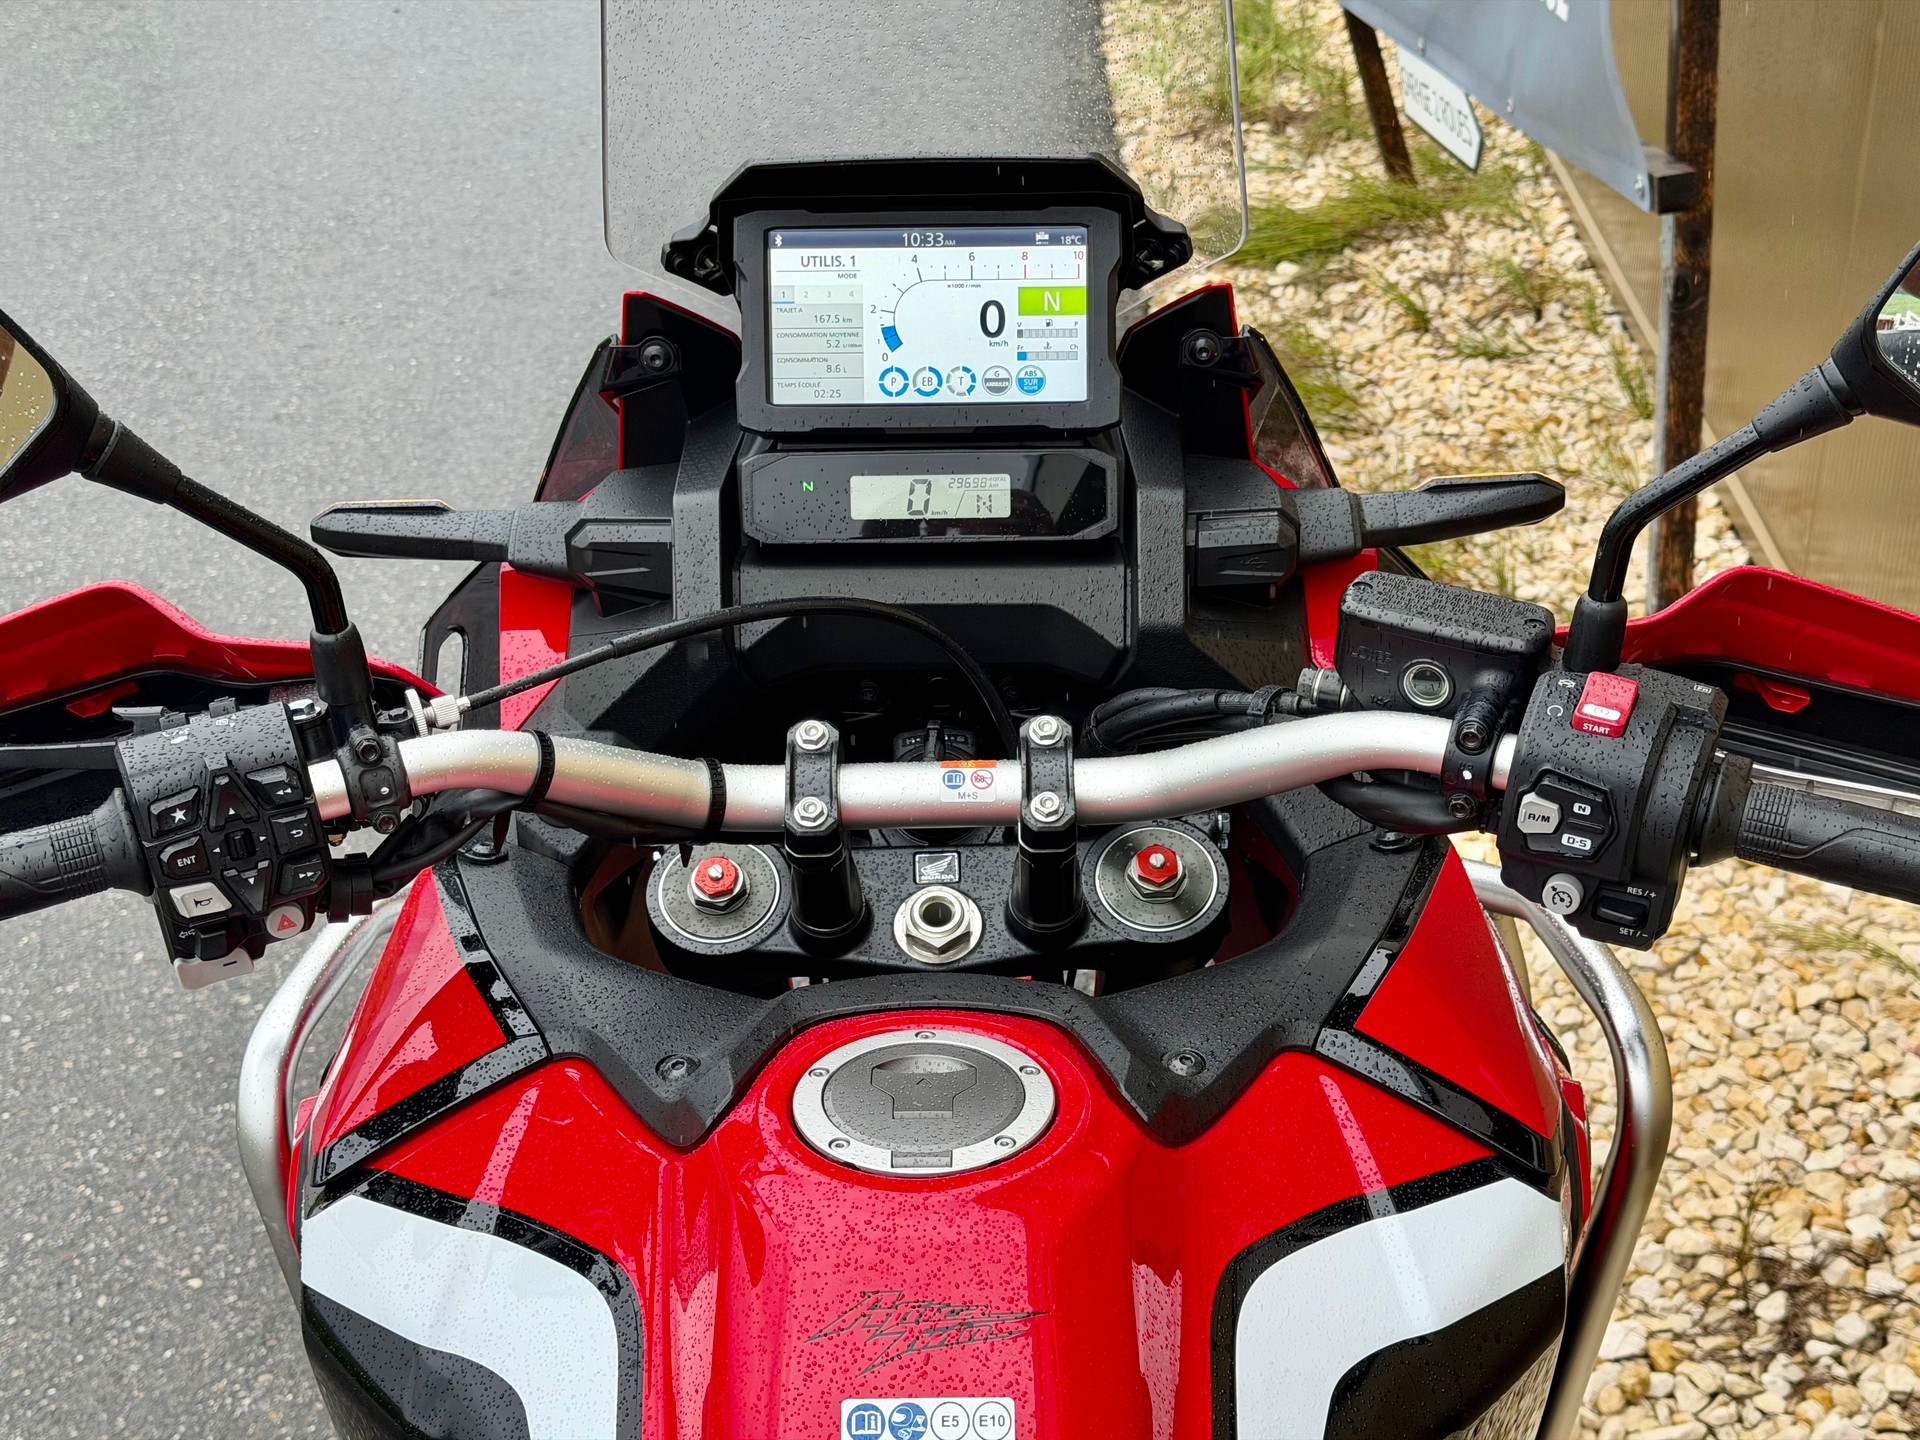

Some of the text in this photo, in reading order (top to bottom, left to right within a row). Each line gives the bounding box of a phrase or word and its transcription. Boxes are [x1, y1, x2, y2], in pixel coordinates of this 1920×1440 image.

[911, 254, 918, 264] 4
[968, 252, 976, 262] 6
[1021, 251, 1029, 261] 8
[1073, 250, 1084, 260] 10
[800, 255, 856, 268] UTILIS. 1
[781, 290, 854, 299] 1 2 3 4
[1043, 292, 1061, 311] N
[870, 304, 877, 314] 2
[813, 314, 841, 324] 167.5
[980, 300, 1006, 339] 0
[826, 339, 841, 349] 5.2
[988, 340, 1009, 348] km/h
[881, 353, 889, 362] 0
[825, 364, 841, 374] 8.6
[890, 377, 897, 386] P
[922, 377, 933, 387] EB
[958, 377, 964, 386] T
[1023, 378, 1039, 386] SUR
[813, 389, 842, 399] 02:25
[803, 481, 813, 492] N
[948, 477, 988, 489] 29698
[907, 478, 948, 517] 0 km/h
[976, 494, 993, 514] N
[1583, 722, 1611, 735] START
[957, 791, 979, 800] M+S
[1578, 805, 1587, 813] N
[1527, 813, 1551, 823] A/M
[1566, 836, 1587, 848] D-S
[176, 855, 196, 868] ENT
[941, 1415, 960, 1428] E5
[979, 1414, 1005, 1428] E10
